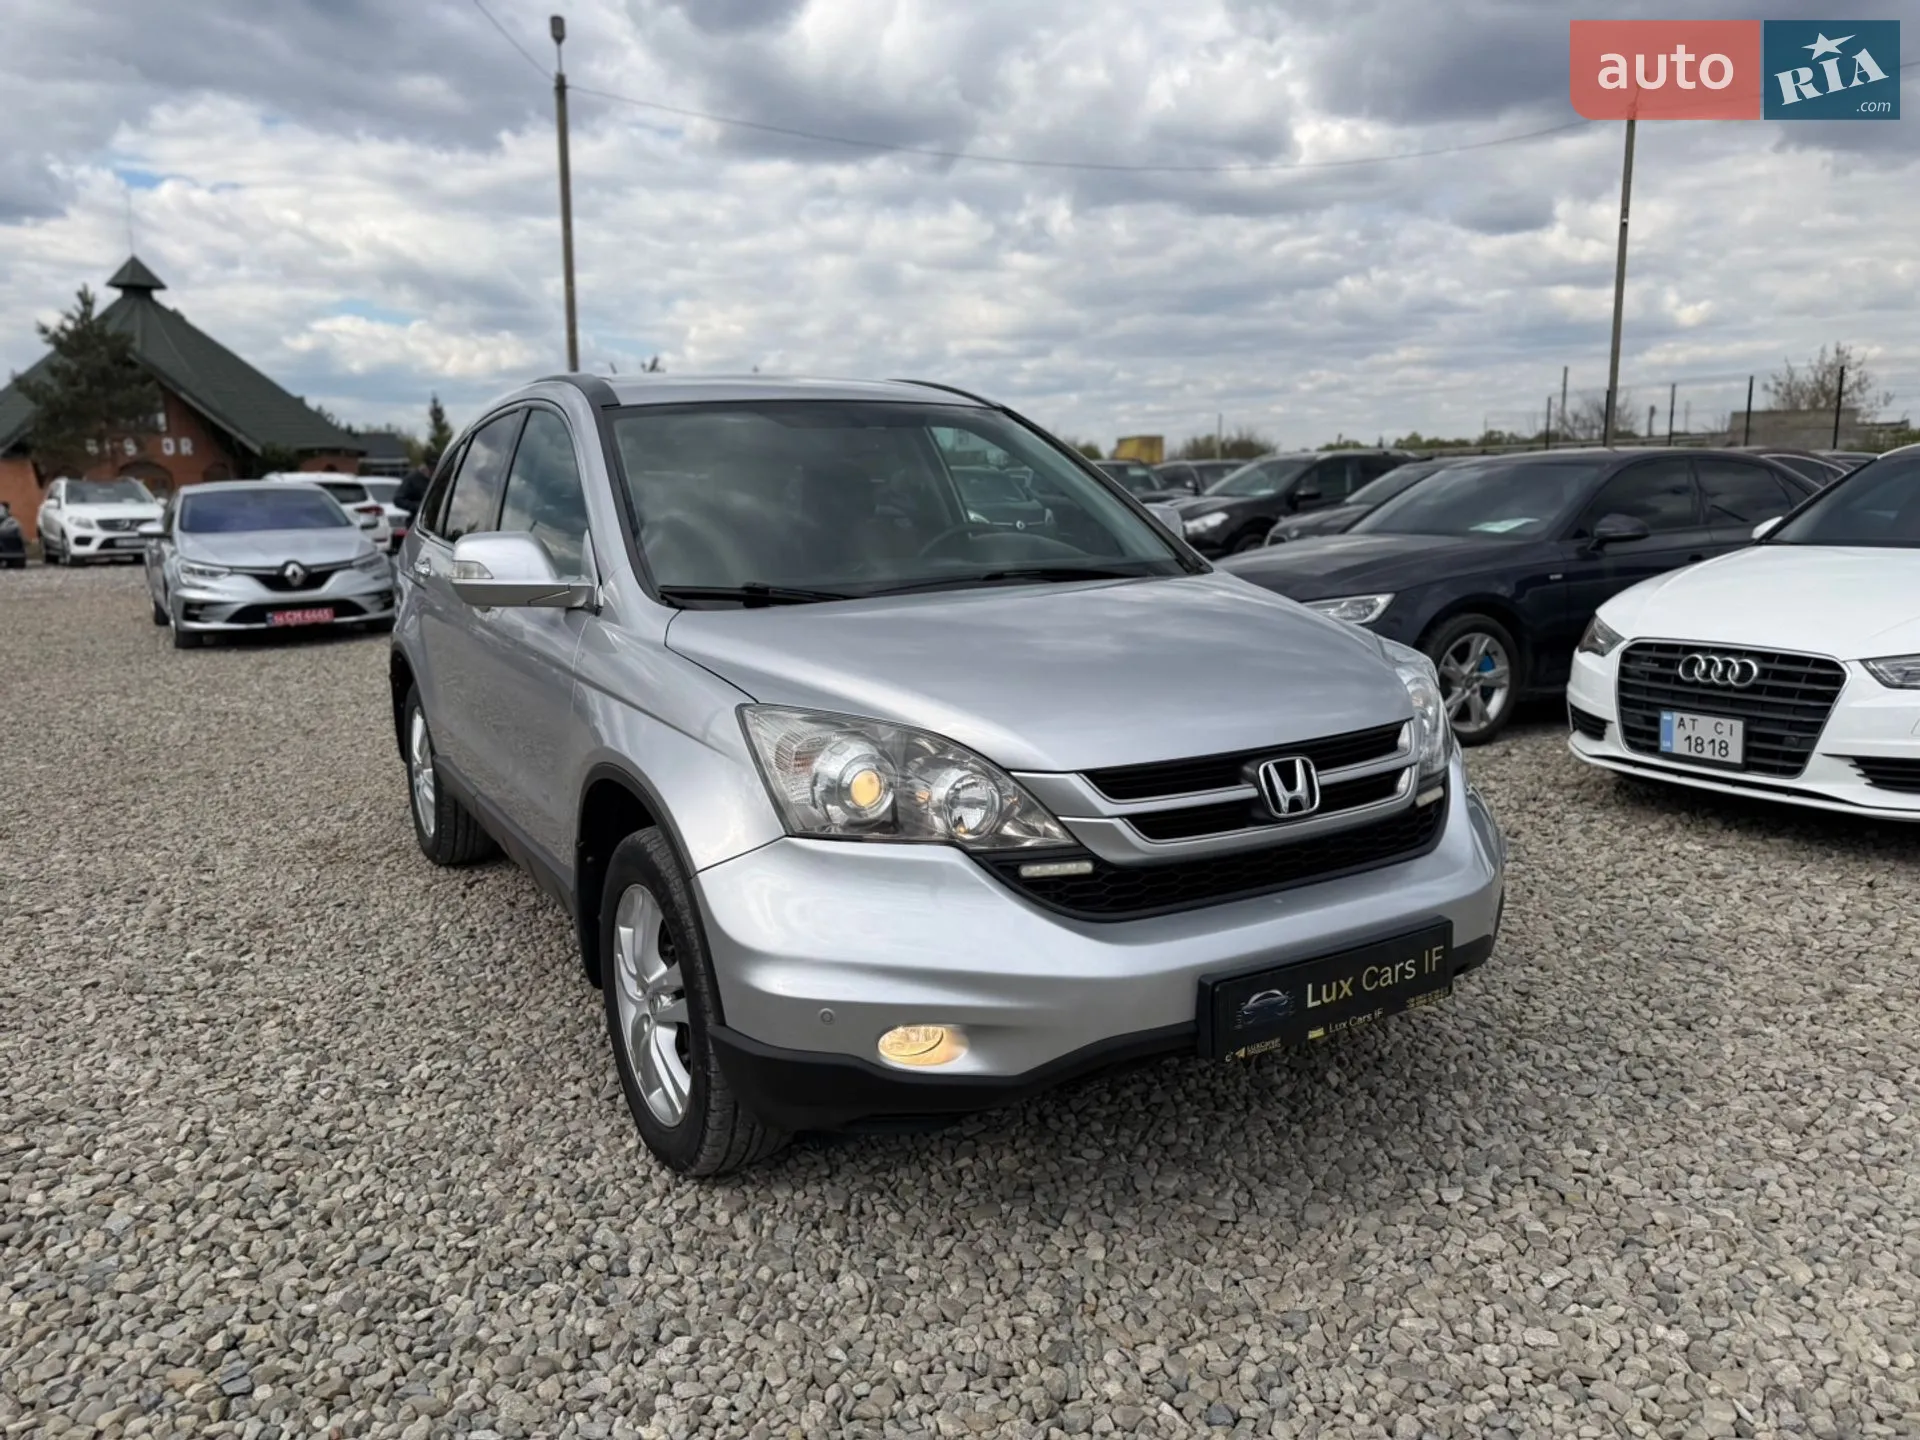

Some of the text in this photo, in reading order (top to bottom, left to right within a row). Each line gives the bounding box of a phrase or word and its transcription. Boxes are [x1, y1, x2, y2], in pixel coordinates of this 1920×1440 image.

[1677, 717, 1698, 731] AT
[1684, 735, 1729, 757] 1818
[1307, 945, 1444, 1008] Lux Cars IF
[1329, 1020, 1348, 1033] Lux
